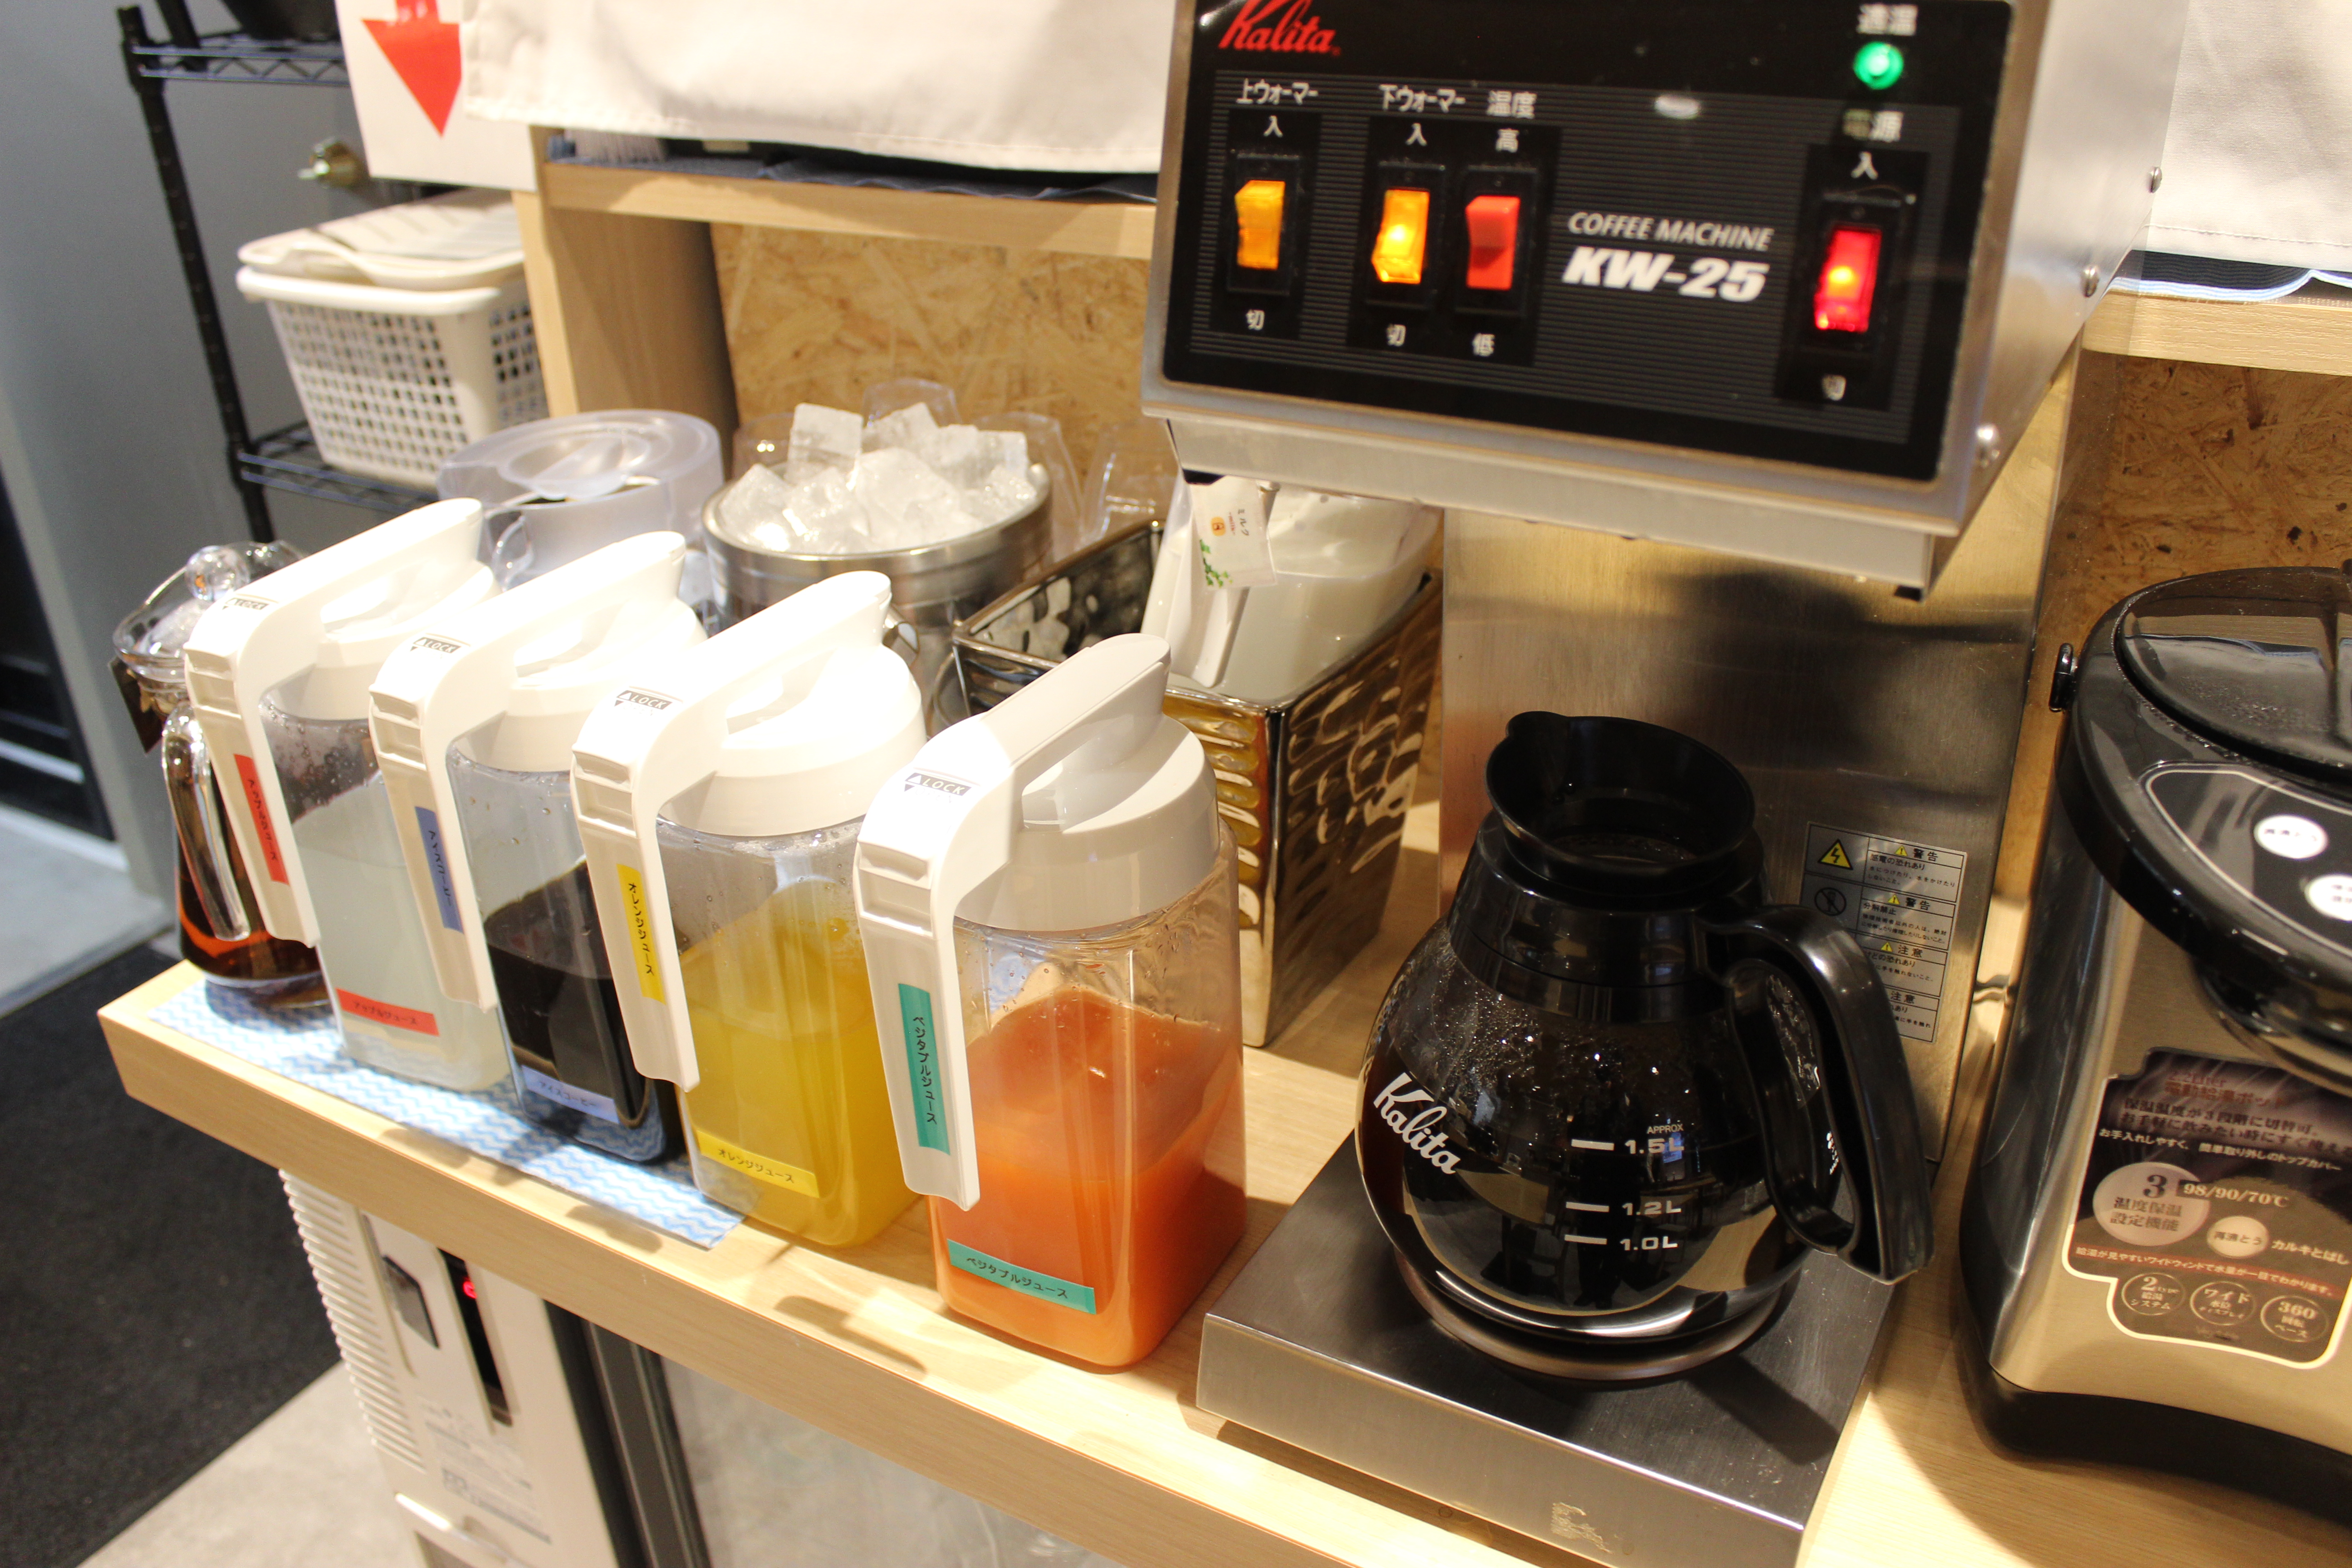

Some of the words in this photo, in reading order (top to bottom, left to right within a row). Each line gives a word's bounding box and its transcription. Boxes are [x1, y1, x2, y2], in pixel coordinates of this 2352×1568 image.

[1219, 0, 1336, 53] Kalita
[1235, 78, 1318, 106] 上ウォーマー
[1379, 84, 1466, 112] 下ウォーマー
[1486, 91, 1537, 119] 温度
[1263, 115, 1283, 137] 入
[1406, 123, 1428, 146] 入
[1495, 128, 1520, 153] 高
[1851, 151, 1879, 180] 入
[1567, 211, 1653, 241] COFFEE
[1654, 218, 1775, 251] MACHINE
[1562, 246, 1770, 302] KW-25
[1246, 309, 1265, 331] 切
[1387, 323, 1406, 347] 切
[1471, 333, 1495, 357] 低
[425, 640, 456, 653] LOCK
[630, 695, 667, 709] LOCK
[922, 778, 965, 795] LOCK
[1913, 848, 1939, 862] 警告
[428, 830, 452, 907] アイスコーヒー
[1906, 897, 1931, 911] 警告
[628, 882, 655, 976] オレンジジュース
[1898, 944, 1923, 958] 注意
[1891, 990, 1916, 1004] 注意
[913, 1016, 937, 1125] ベジタブルジュース
[1372, 1072, 1462, 1175] Kalita
[1646, 1123, 1684, 1134] APPROX
[1625, 1137, 1685, 1154] 1.5L
[718, 1148, 794, 1184] オレンジジュース
[2143, 1174, 2168, 1199] 3
[1622, 1200, 1682, 1216] 1.2L
[2113, 1196, 2183, 1217] 温度保温
[2110, 1211, 2179, 1232] 設定機能
[1619, 1235, 1678, 1251] 1.0L
[2271, 1240, 2350, 1265] カルキとばし
[966, 1257, 1068, 1299] ベジタブルジュース
[2131, 1298, 2171, 1310] システム
[2204, 1288, 2252, 1304] ワイド
[2278, 1301, 2318, 1320] 360
